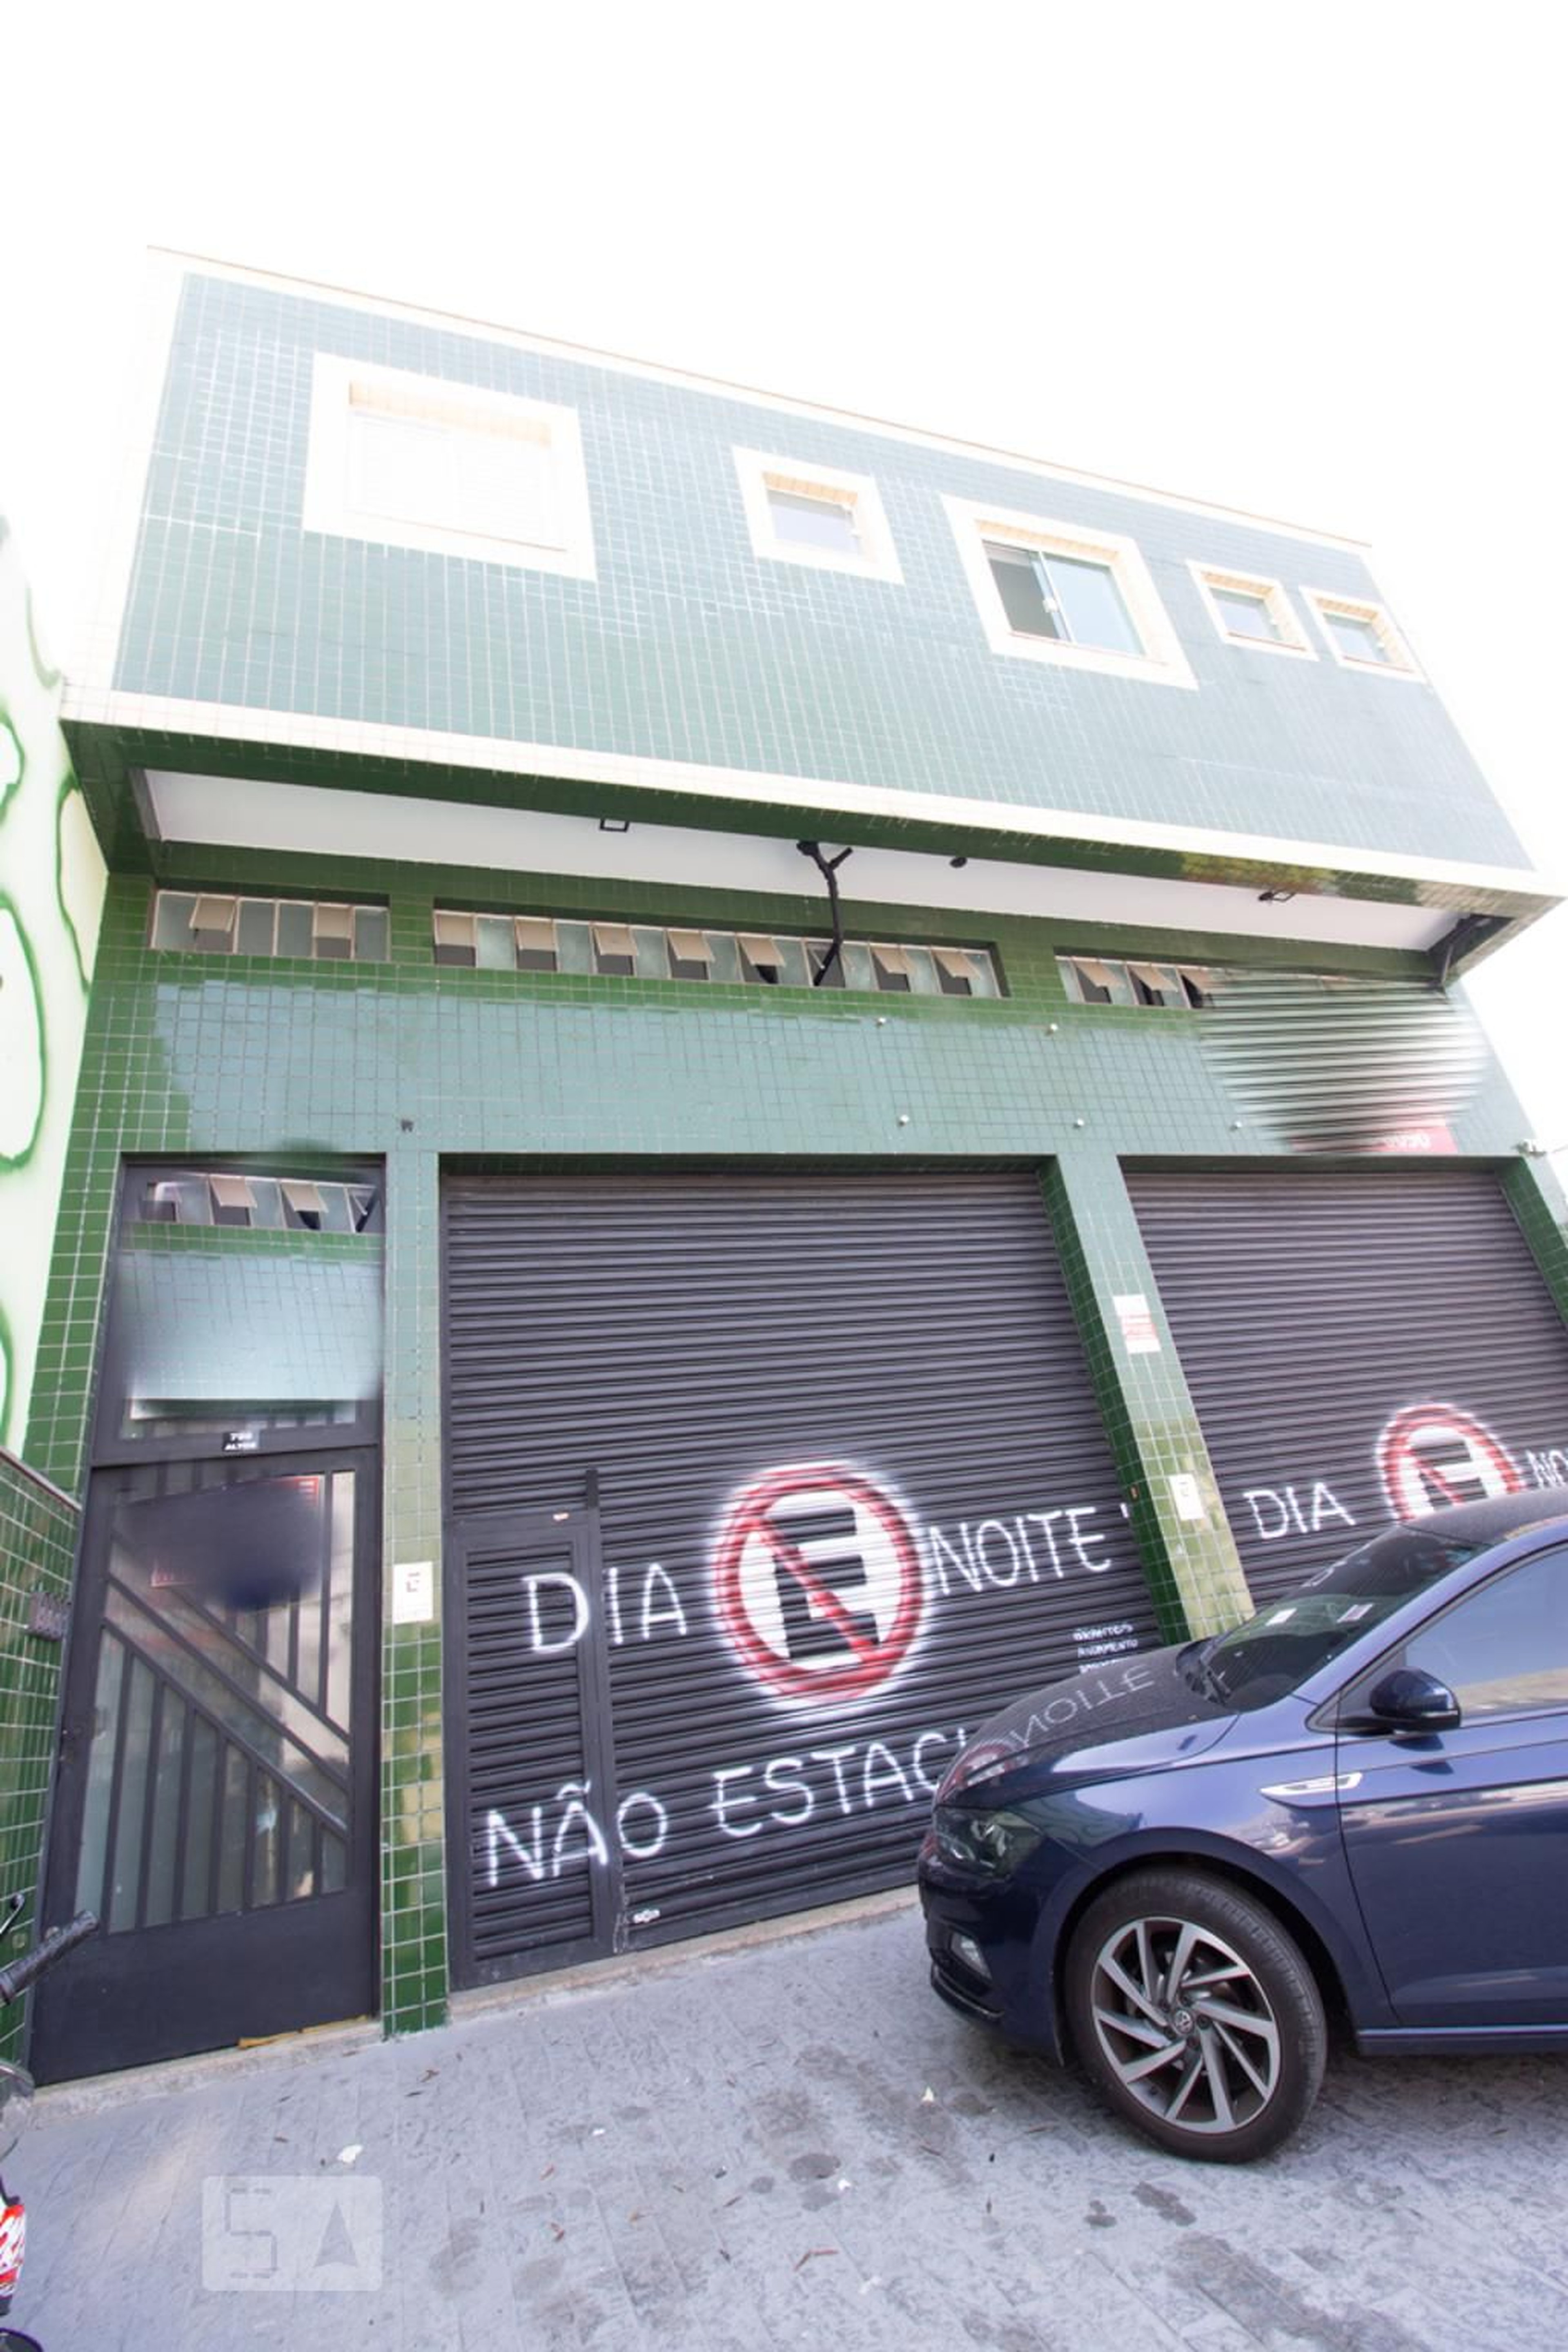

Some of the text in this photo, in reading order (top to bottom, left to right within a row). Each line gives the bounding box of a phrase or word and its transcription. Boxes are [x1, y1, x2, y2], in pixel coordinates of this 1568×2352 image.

[1243, 1482, 1355, 1539] DIA
[521, 1507, 1111, 1654] DIA NOITE
[487, 1780, 668, 1886] NÃO
